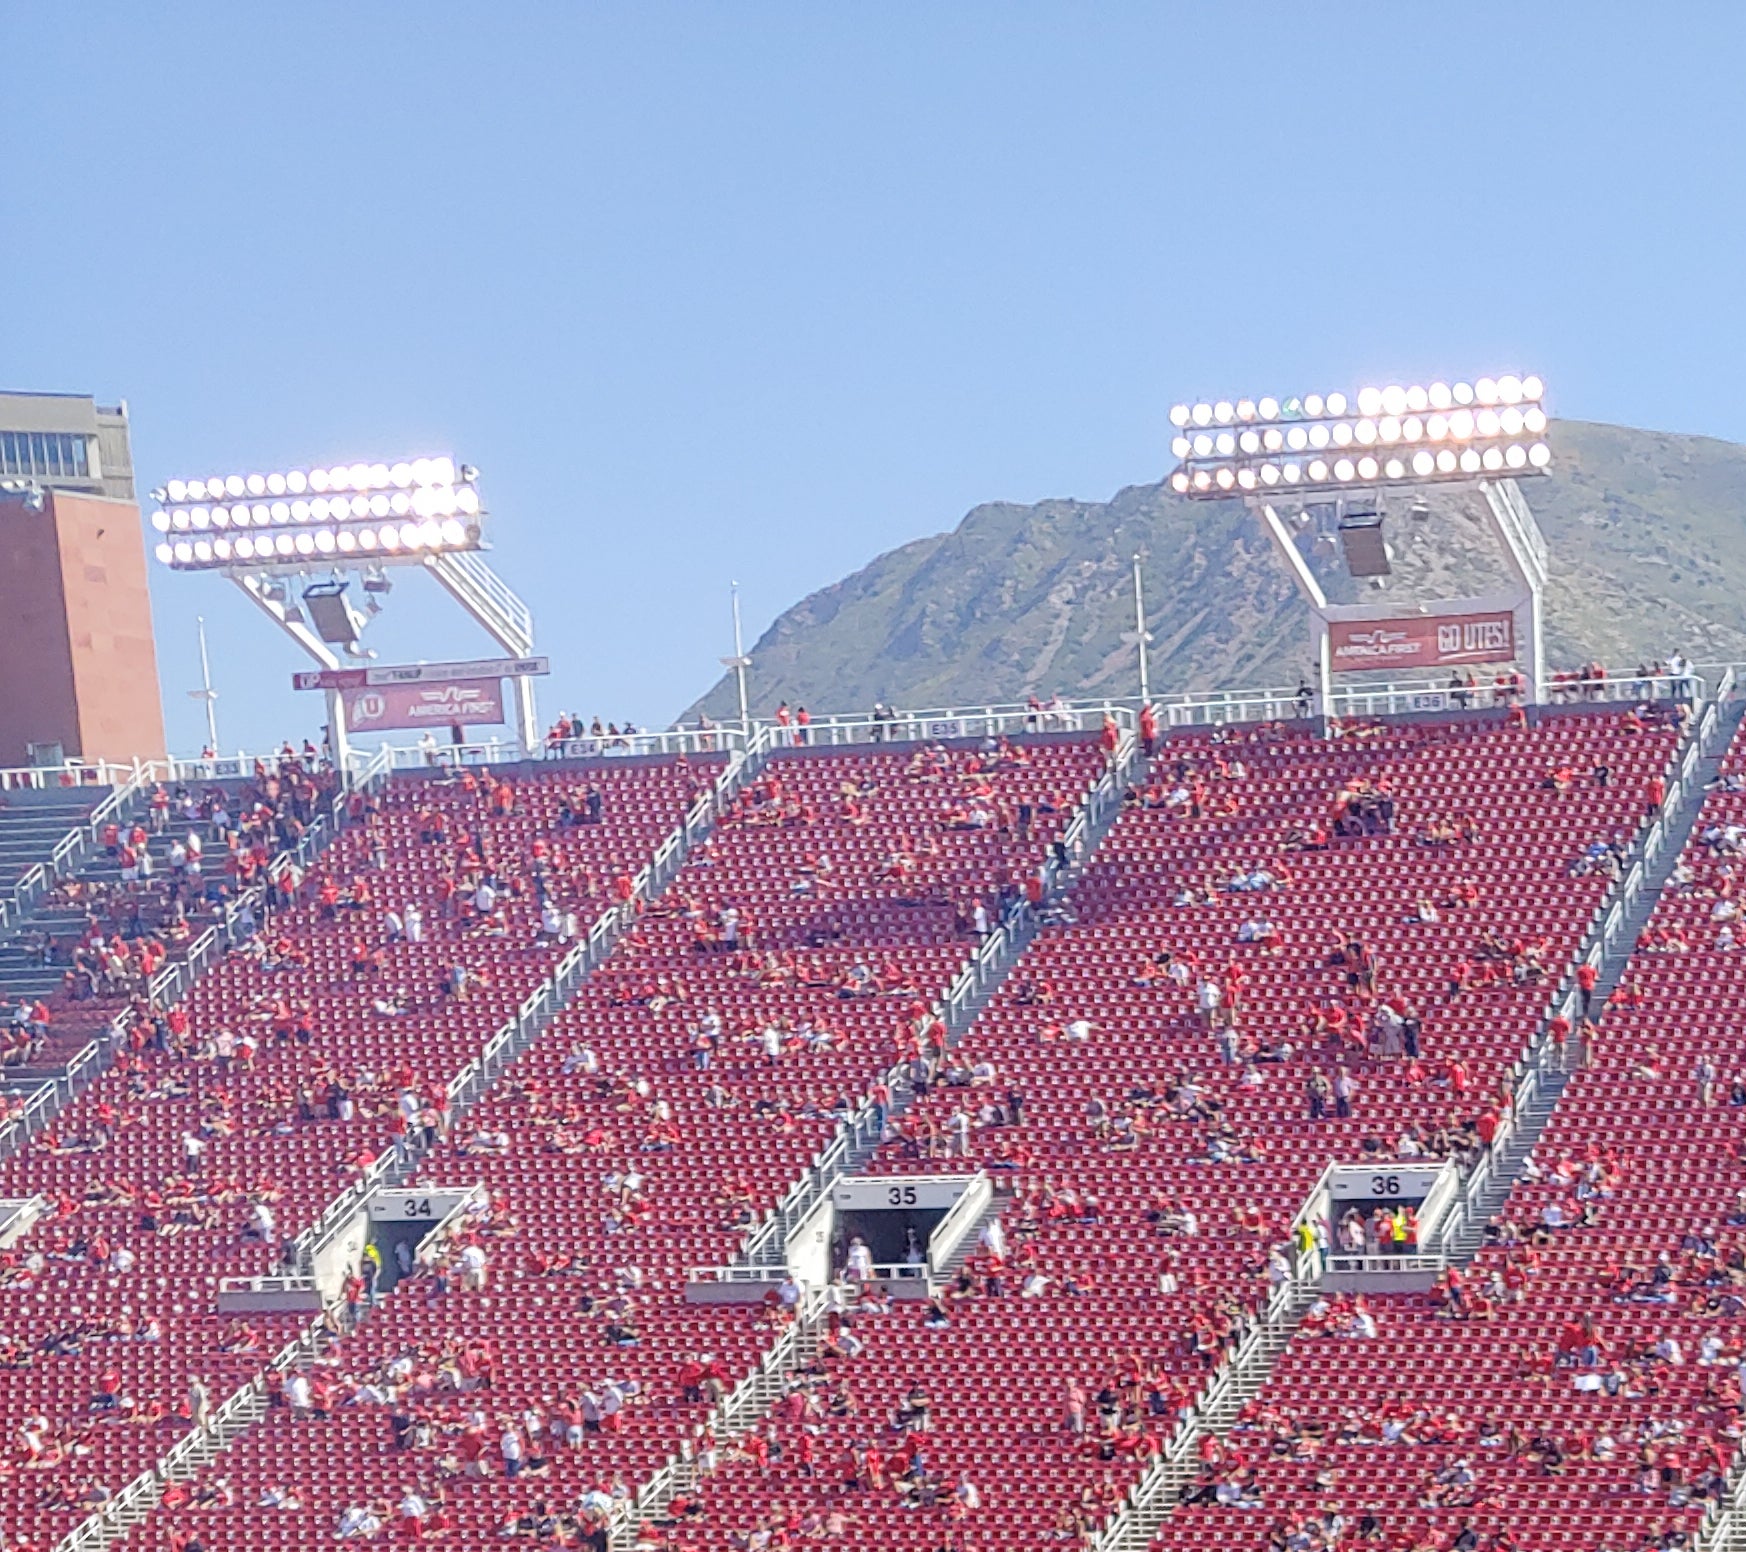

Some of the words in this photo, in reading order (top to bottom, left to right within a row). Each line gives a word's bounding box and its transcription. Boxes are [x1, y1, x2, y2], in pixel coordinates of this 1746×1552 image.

[1437, 624, 1462, 653] GO
[1463, 620, 1511, 650] UTES!
[408, 702, 461, 716] AMERICA
[1371, 1176, 1400, 1195] 36
[888, 1186, 917, 1206] 35
[404, 1199, 431, 1217] 34
